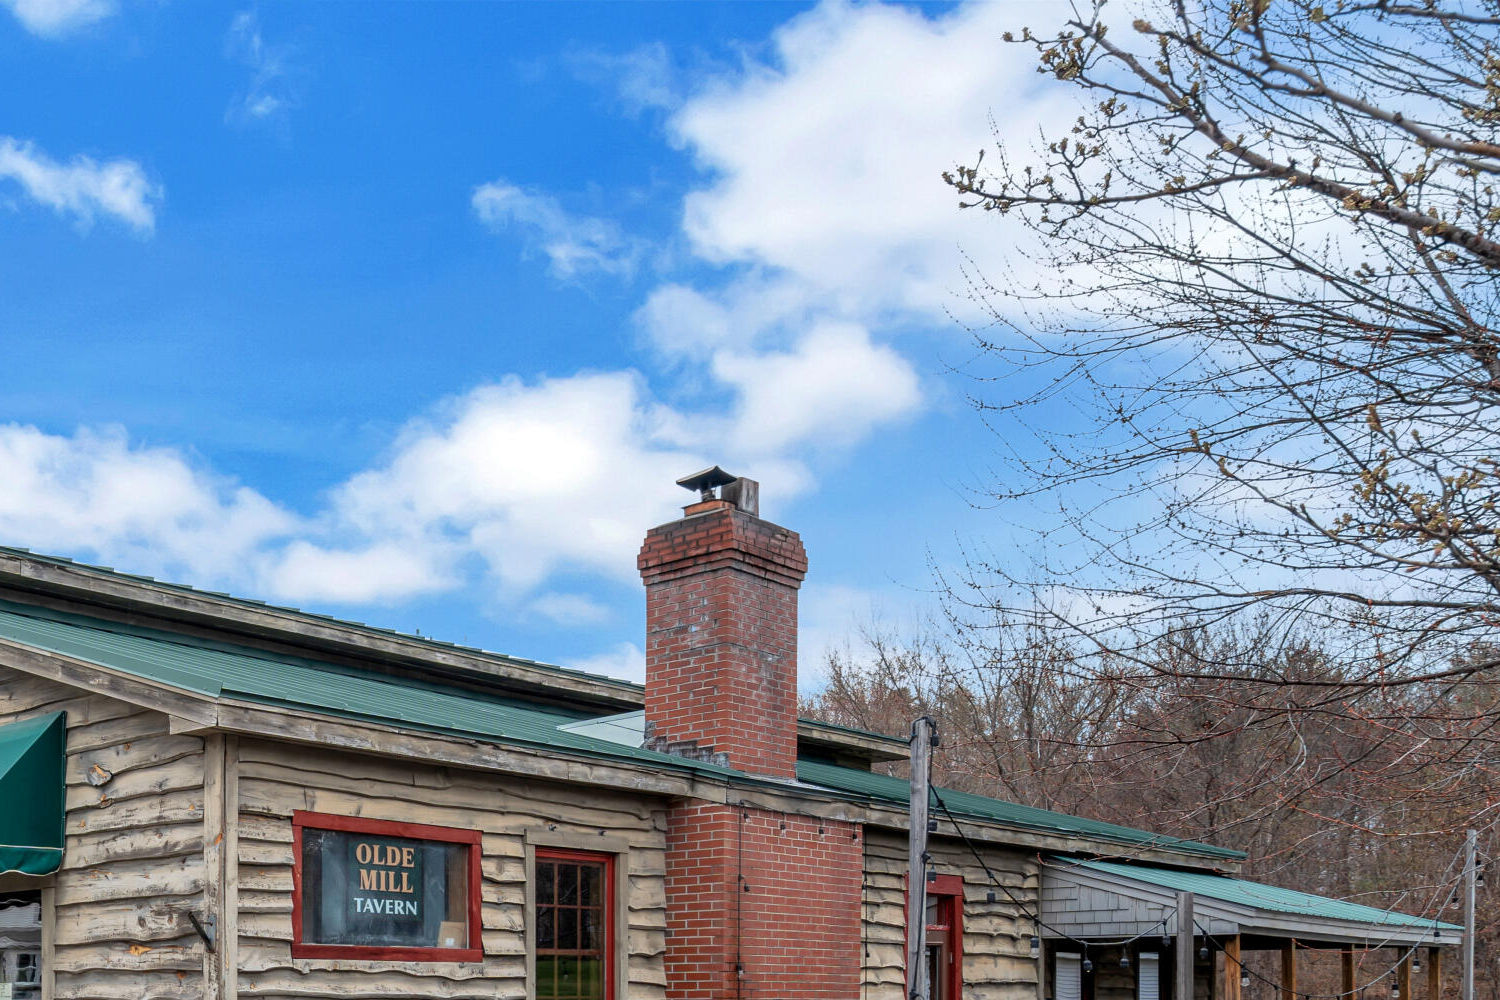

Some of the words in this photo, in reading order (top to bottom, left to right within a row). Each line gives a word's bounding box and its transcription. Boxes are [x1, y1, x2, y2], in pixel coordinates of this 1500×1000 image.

[355, 843, 415, 868] OLDE
[358, 868, 414, 894] MILL
[353, 897, 418, 916] TAVERN
